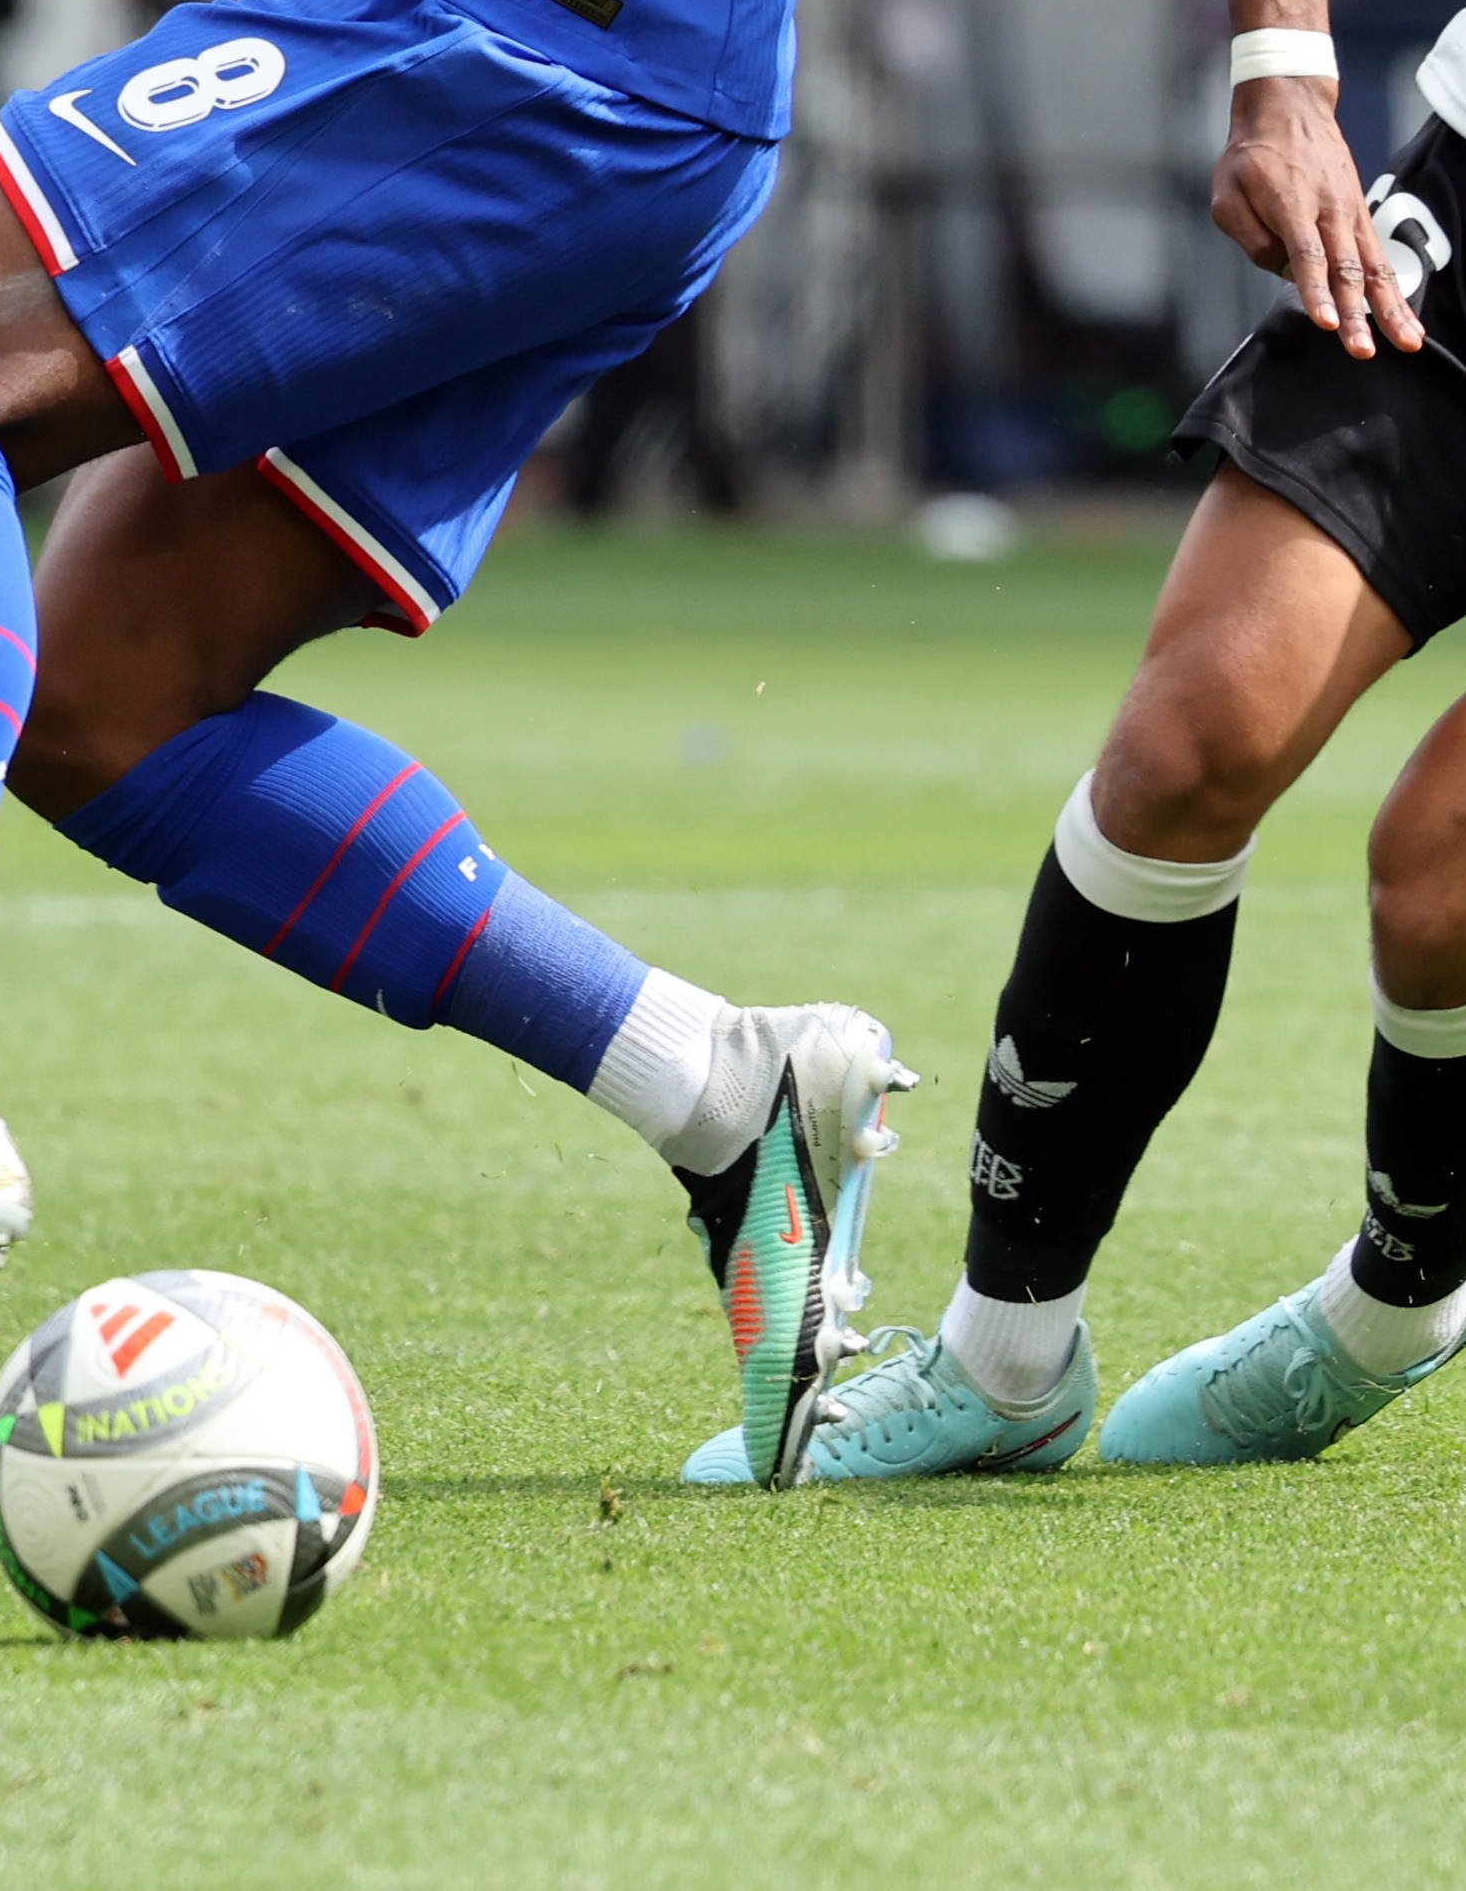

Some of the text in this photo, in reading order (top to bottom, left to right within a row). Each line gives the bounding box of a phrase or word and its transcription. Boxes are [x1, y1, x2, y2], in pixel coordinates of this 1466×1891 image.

[117, 37, 287, 132] 8
[1363, 173, 1453, 314] 6
[129, 1477, 269, 1560] LEAGUE
